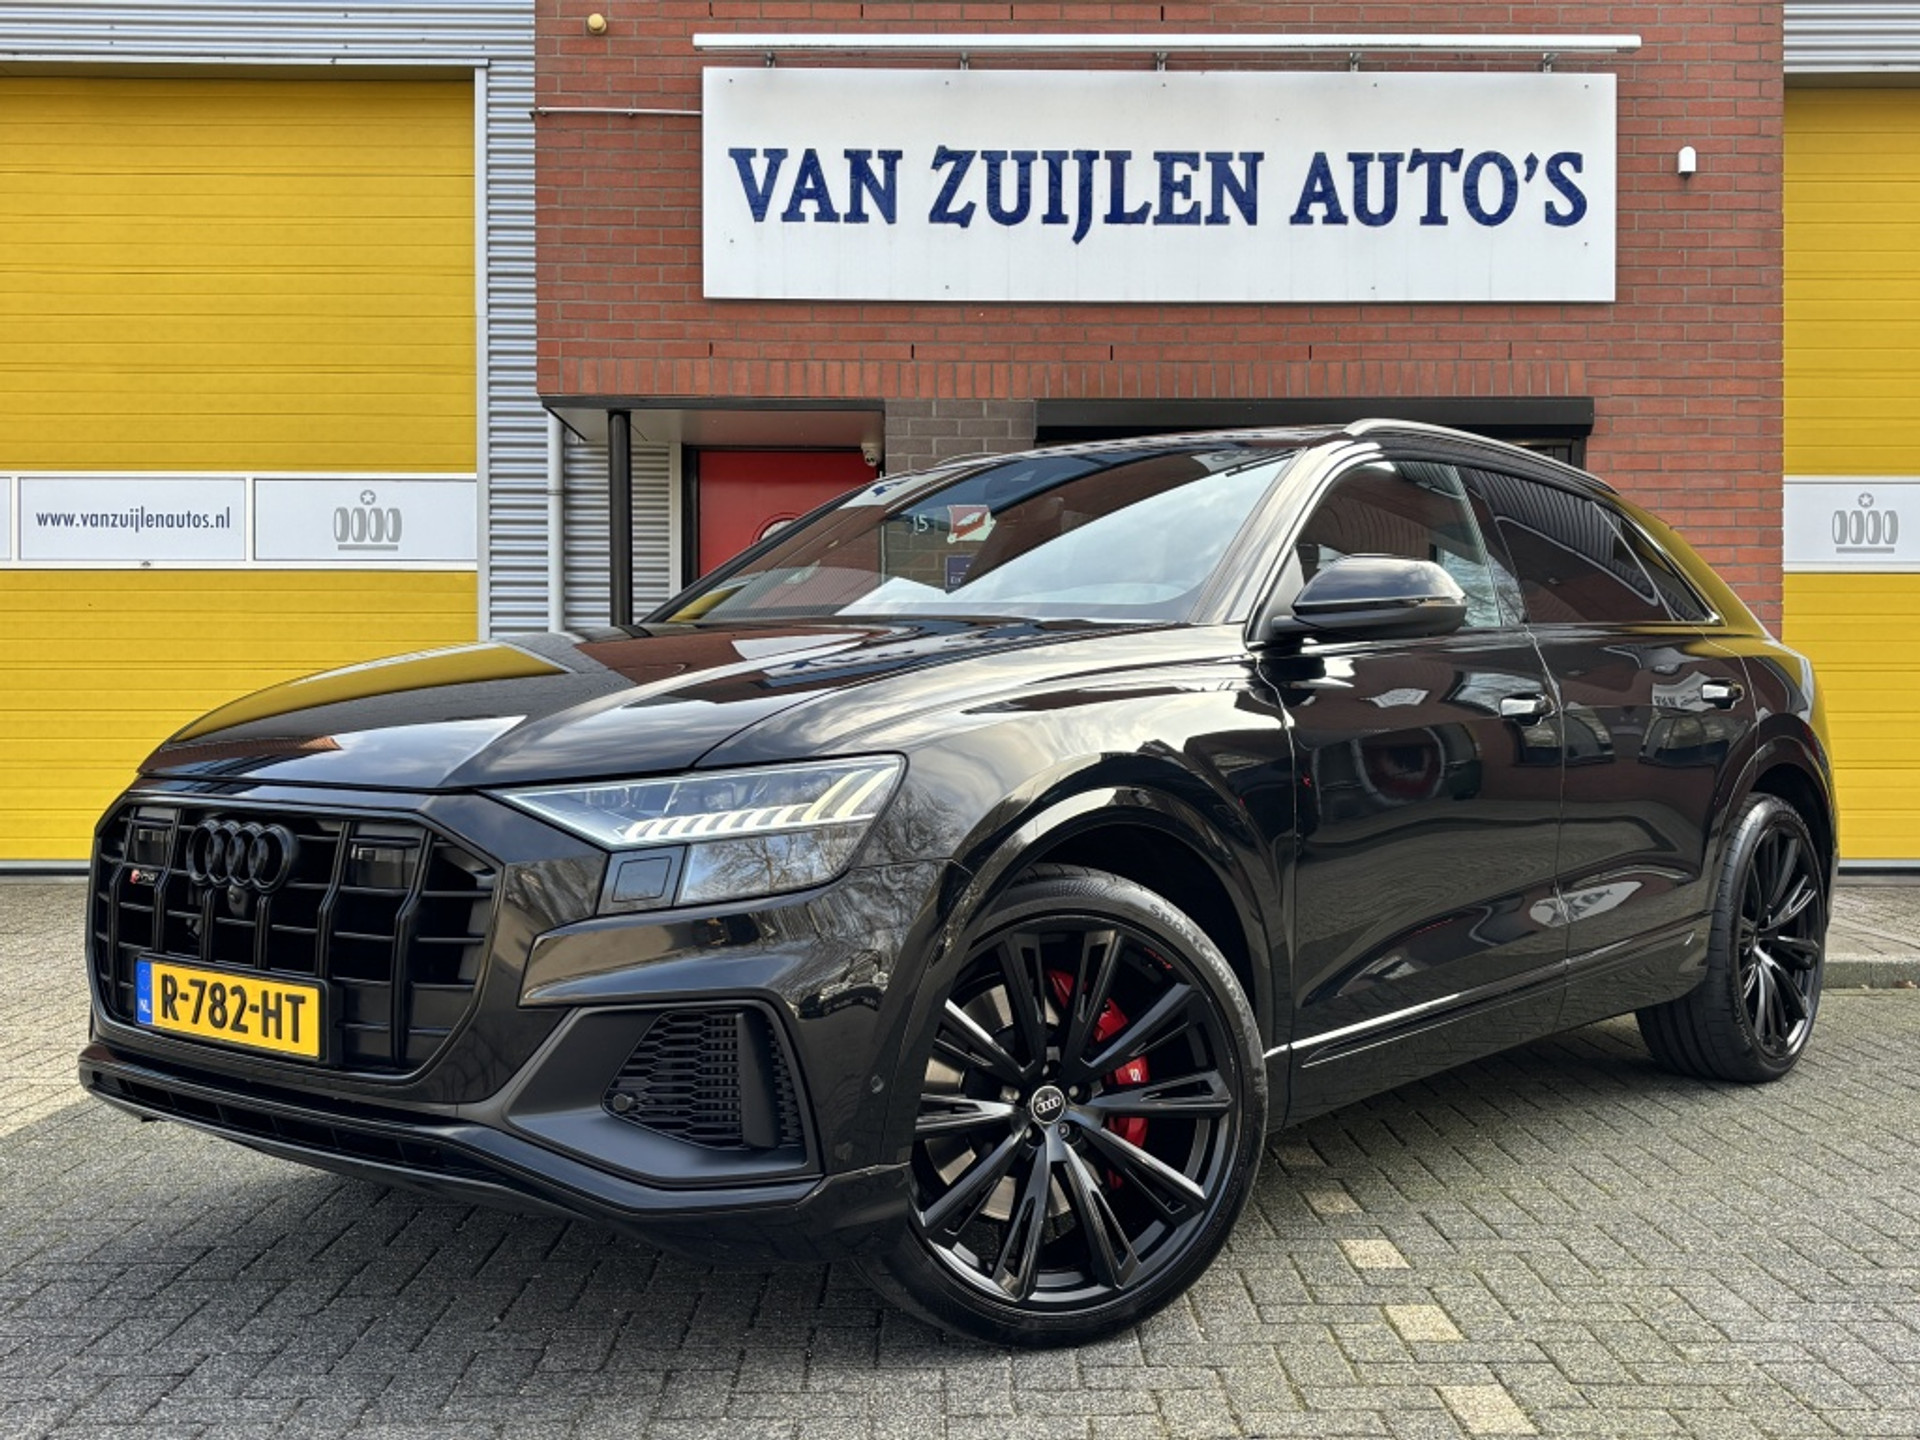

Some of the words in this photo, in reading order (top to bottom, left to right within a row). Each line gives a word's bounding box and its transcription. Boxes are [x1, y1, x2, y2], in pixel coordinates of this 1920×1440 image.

[728, 148, 903, 224] VAN
[929, 145, 1264, 244] ZUIJLEN
[1290, 148, 1588, 227] AUTO'S
[36, 505, 230, 533] www.vanzuijlenautos.nl
[161, 973, 306, 1043] R-782-HT
